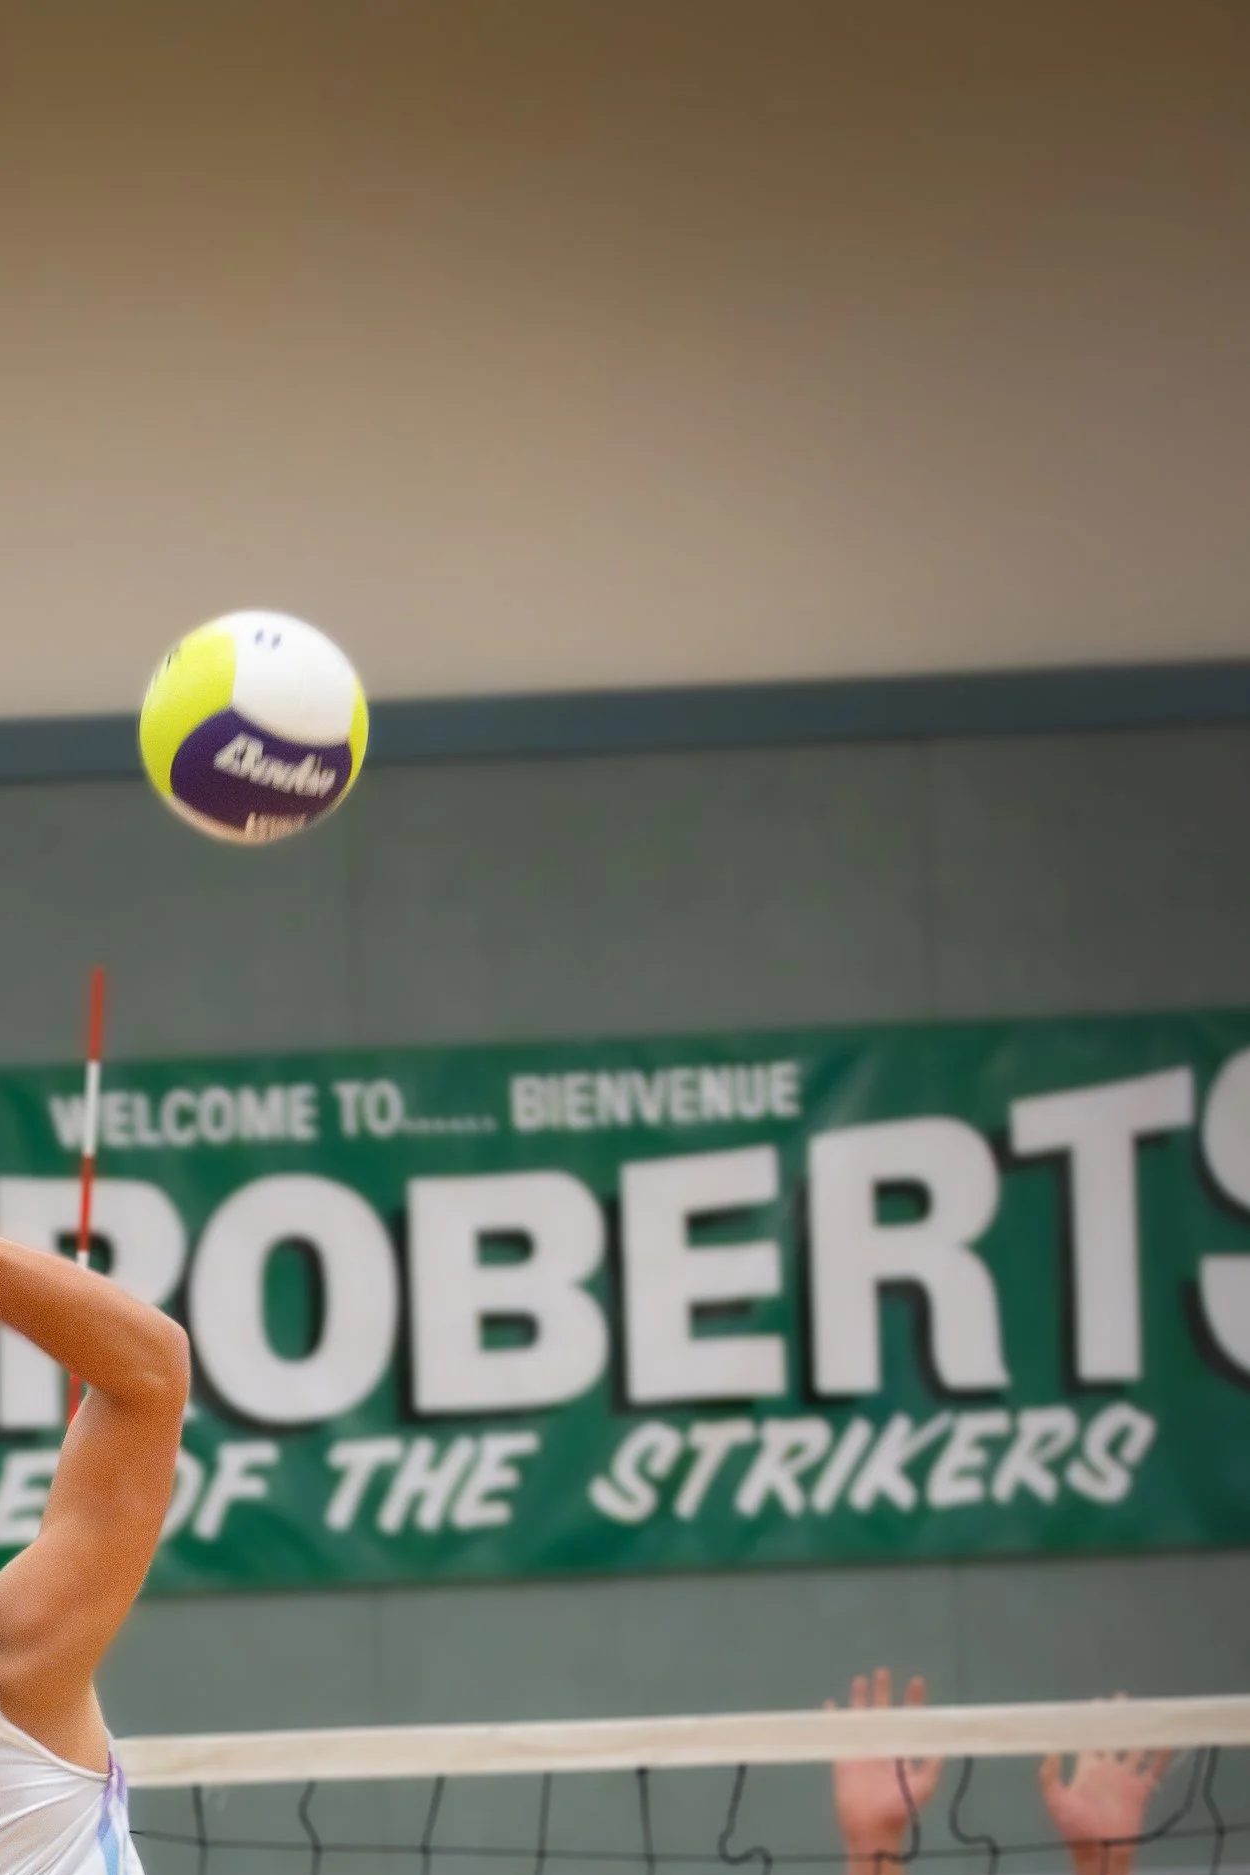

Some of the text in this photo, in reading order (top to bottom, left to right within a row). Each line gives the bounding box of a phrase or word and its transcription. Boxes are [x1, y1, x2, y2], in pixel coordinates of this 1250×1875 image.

[49, 1083, 319, 1150] WELCOME
[511, 1061, 800, 1132] BIENVENUE
[324, 1432, 540, 1536] THE
[588, 1403, 1155, 1524] STRIKERS
